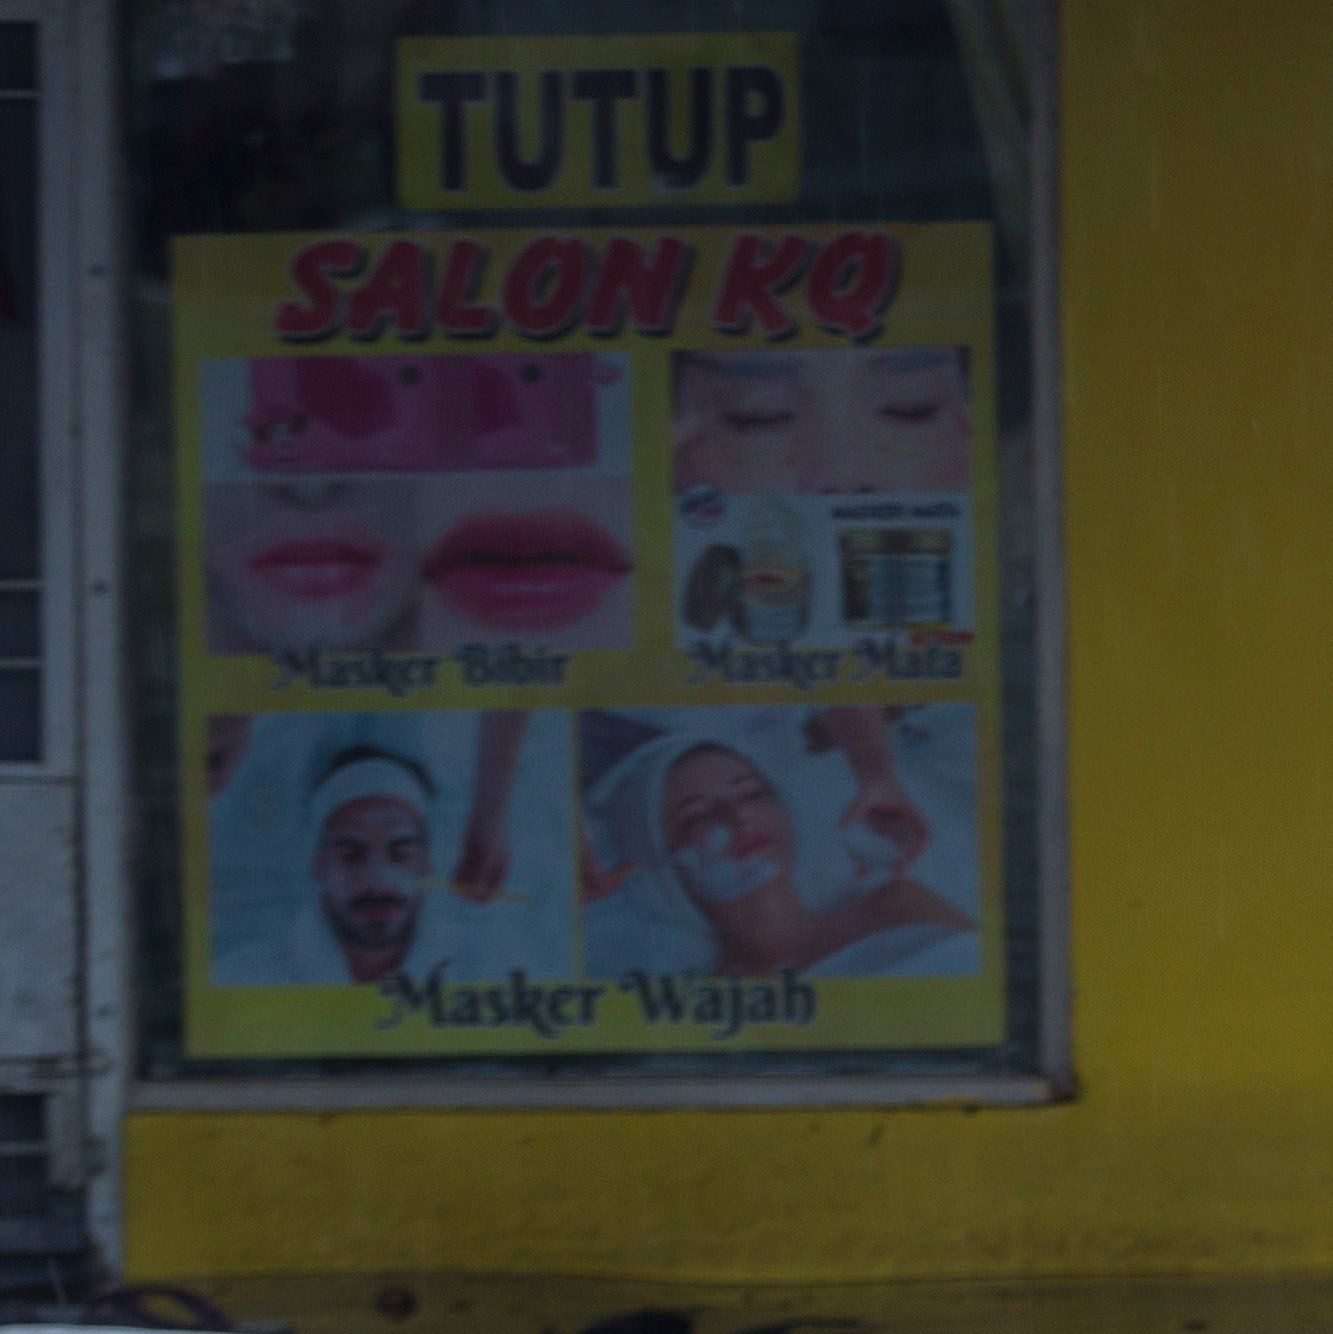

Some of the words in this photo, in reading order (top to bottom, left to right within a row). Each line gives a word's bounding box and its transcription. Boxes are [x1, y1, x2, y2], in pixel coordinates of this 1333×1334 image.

[418, 66, 784, 192] TUTUP
[275, 237, 693, 342] SALON
[270, 641, 440, 697] Masker
[687, 639, 840, 690] Masker
[849, 638, 962, 682] Mata
[375, 959, 606, 1039] Masker
[622, 967, 815, 1040] Wajah
